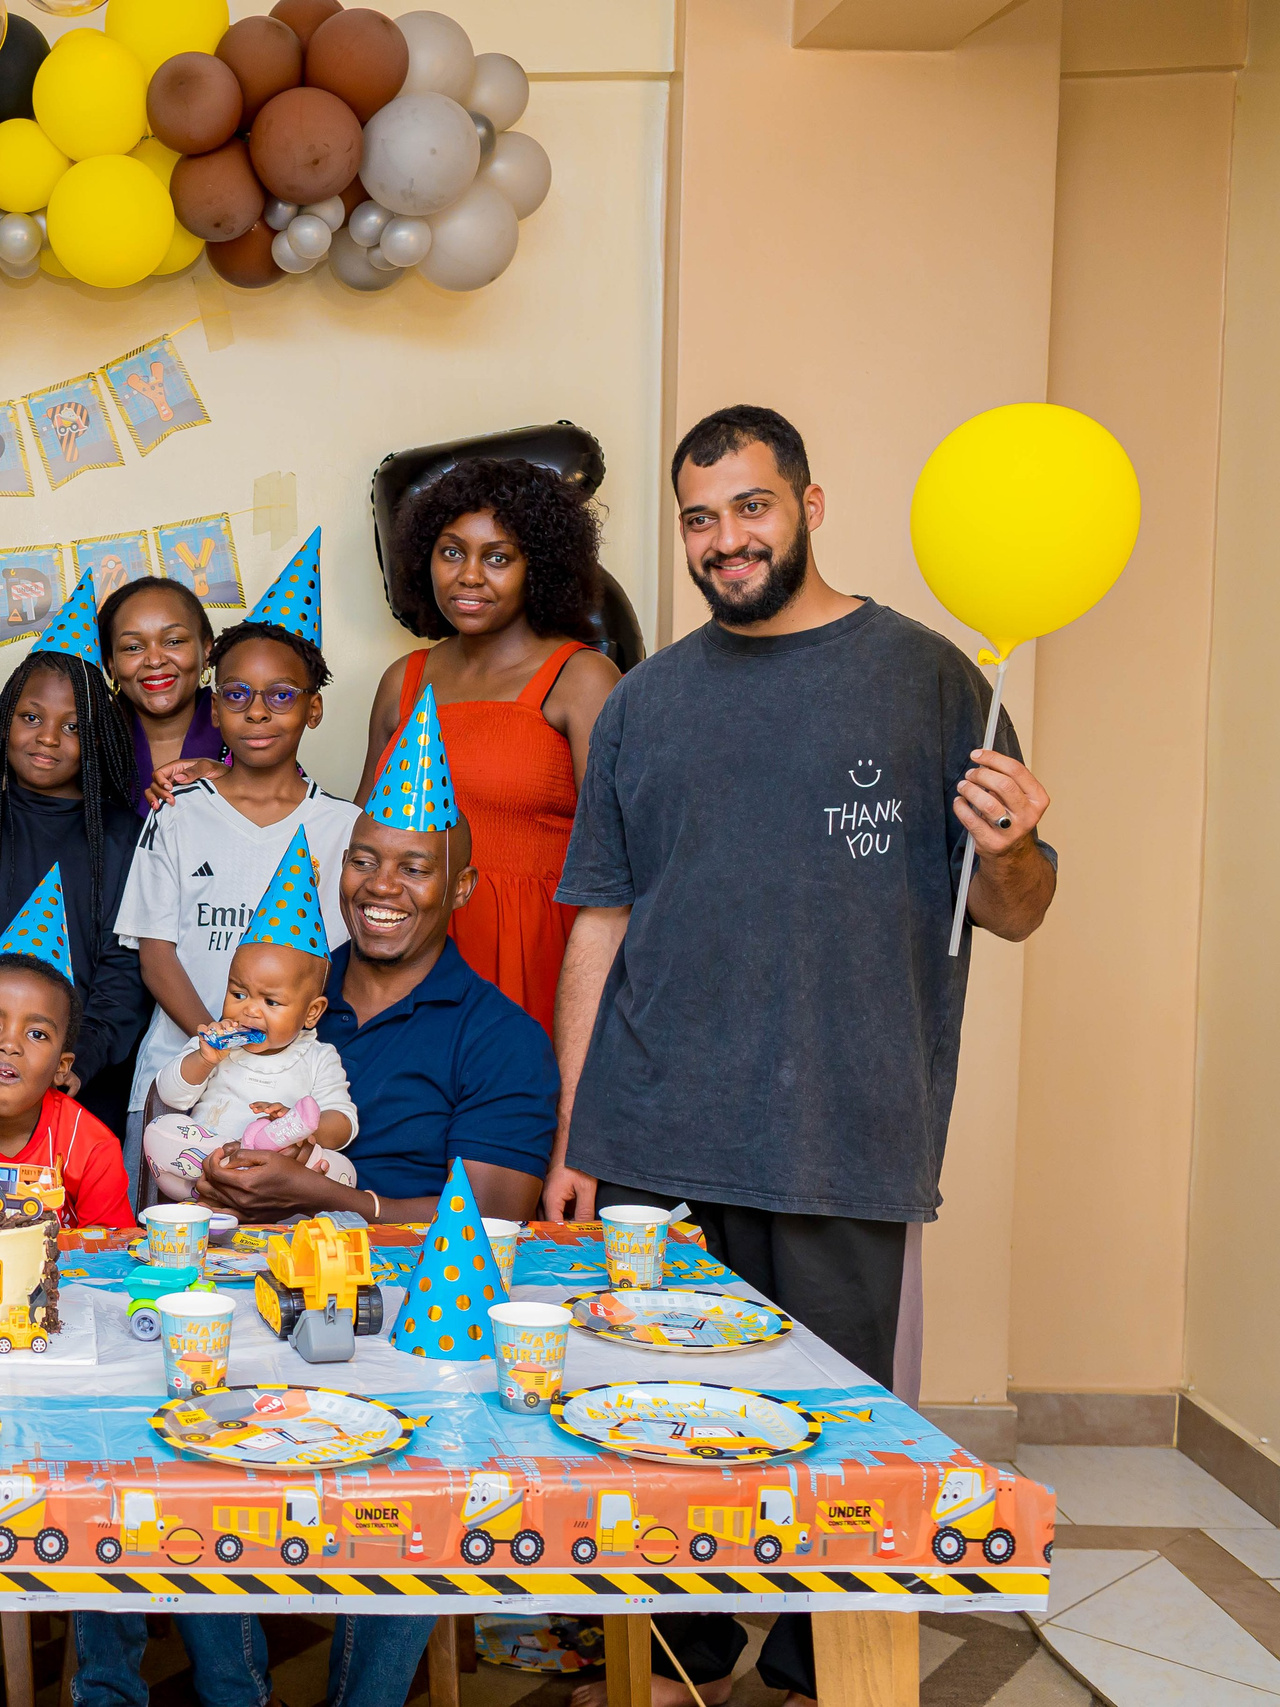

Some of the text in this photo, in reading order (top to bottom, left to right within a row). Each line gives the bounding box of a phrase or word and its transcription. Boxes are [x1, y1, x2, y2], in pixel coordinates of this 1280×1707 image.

[824, 799, 902, 835] THANK
[846, 832, 891, 859] YOU
[208, 931, 233, 951] FLY
[615, 1393, 706, 1411] HAPPY
[354, 1508, 399, 1521] UNDER
[828, 1505, 871, 1518] UNDER
